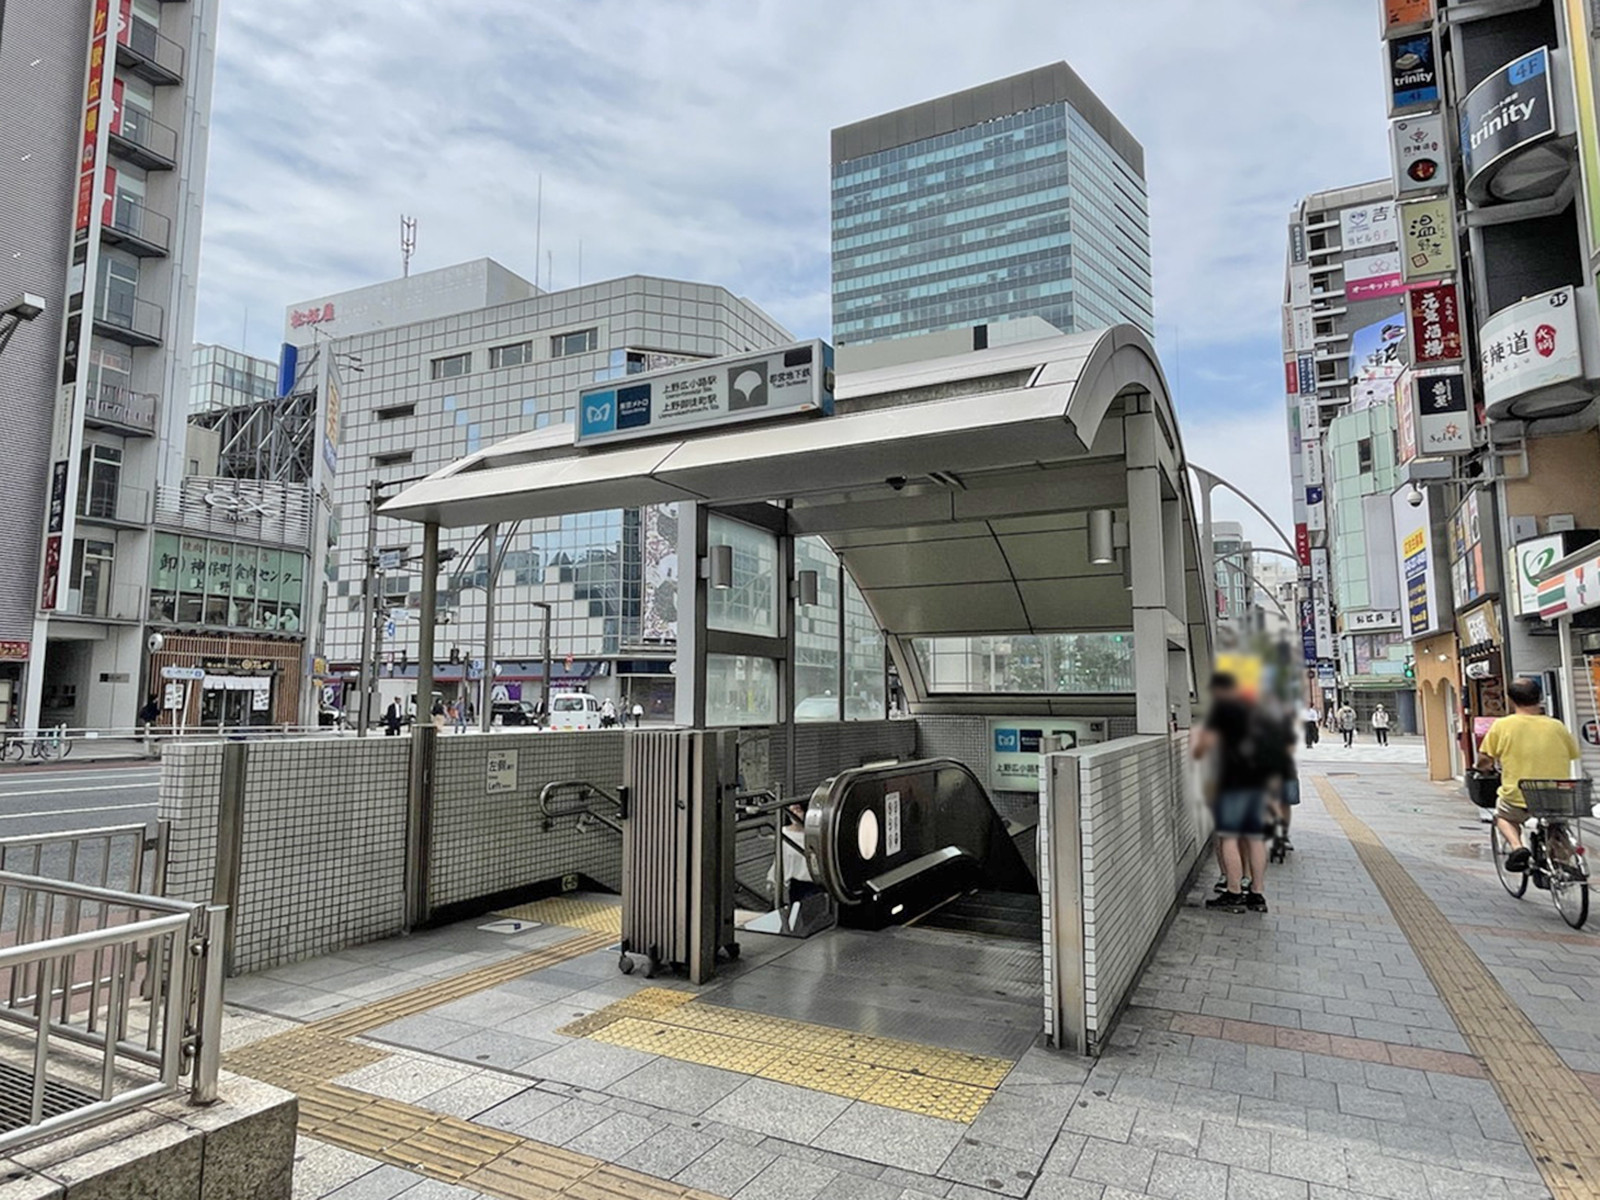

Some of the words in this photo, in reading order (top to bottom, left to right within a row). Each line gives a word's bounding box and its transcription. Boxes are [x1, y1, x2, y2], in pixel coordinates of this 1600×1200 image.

[1515, 57, 1538, 79] 4F
[1394, 72, 1433, 86] trinity
[1470, 97, 1536, 150] trinity
[1551, 293, 1567, 308] 3F
[662, 375, 718, 394] 上野広小路駅
